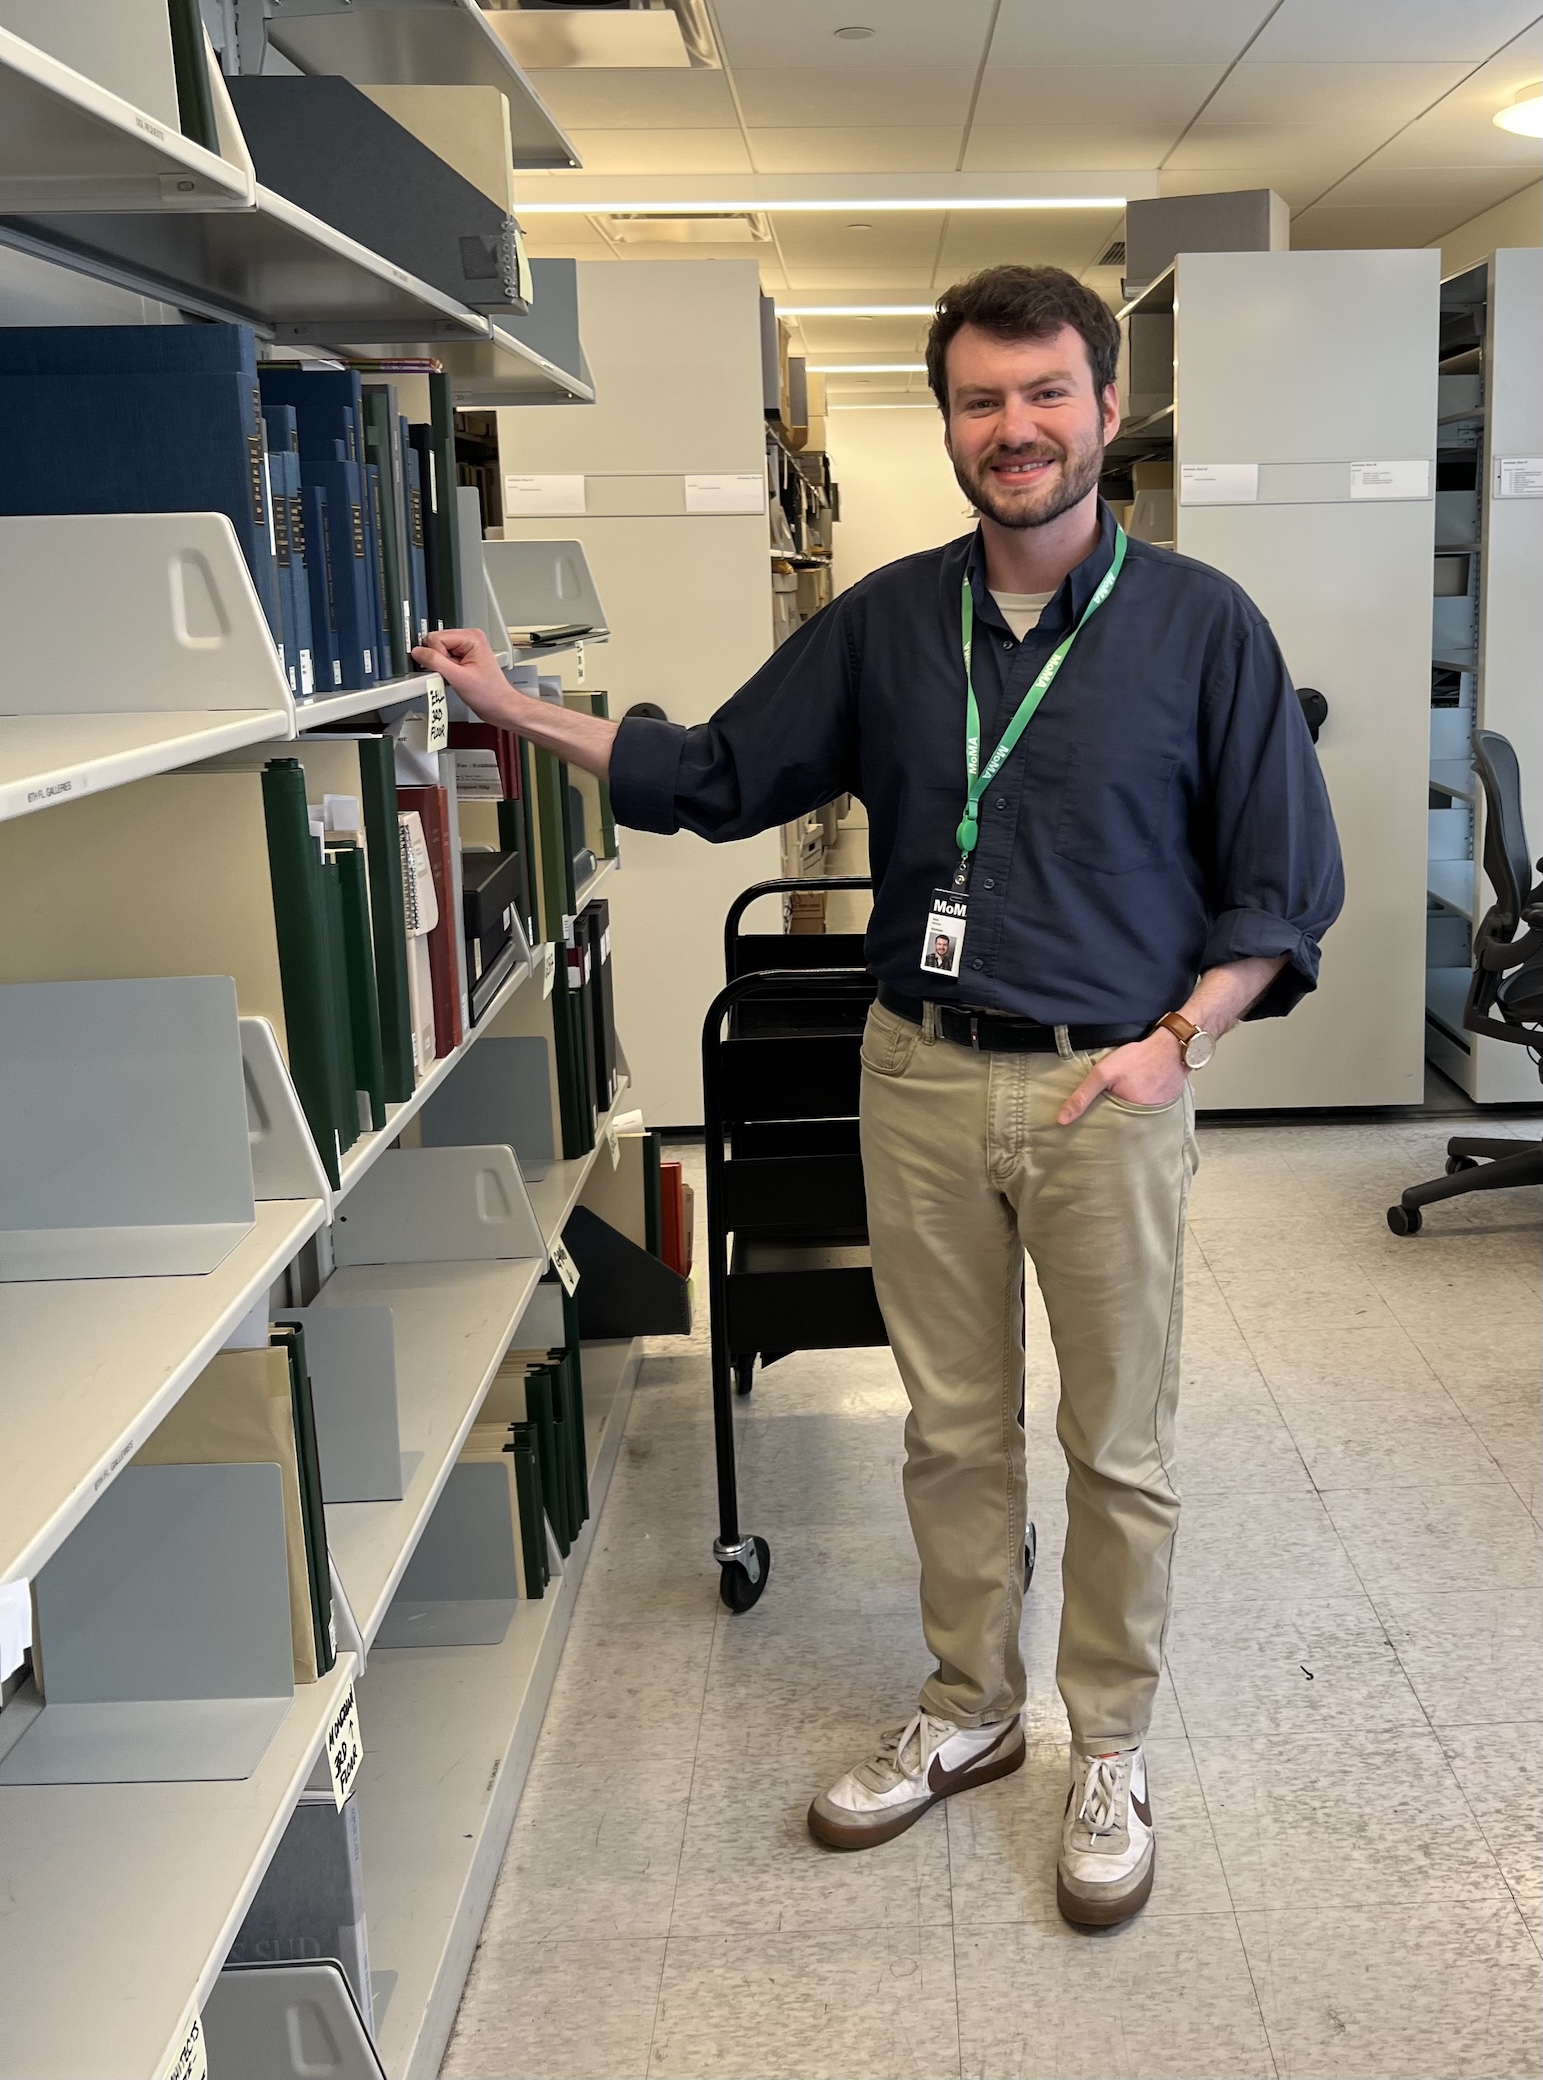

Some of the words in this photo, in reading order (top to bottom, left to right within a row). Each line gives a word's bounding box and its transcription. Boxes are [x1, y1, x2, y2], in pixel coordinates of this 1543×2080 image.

[1093, 572, 1116, 605] MoMA
[1035, 655, 1063, 688] MoMA
[431, 724, 445, 742] FLOOR
[968, 737, 978, 775] MoMA
[982, 745, 1009, 779] MoMA
[46, 781, 72, 797] GALLERIES
[933, 899, 967, 917] MoM
[333, 1741, 347, 1779] 3RD
